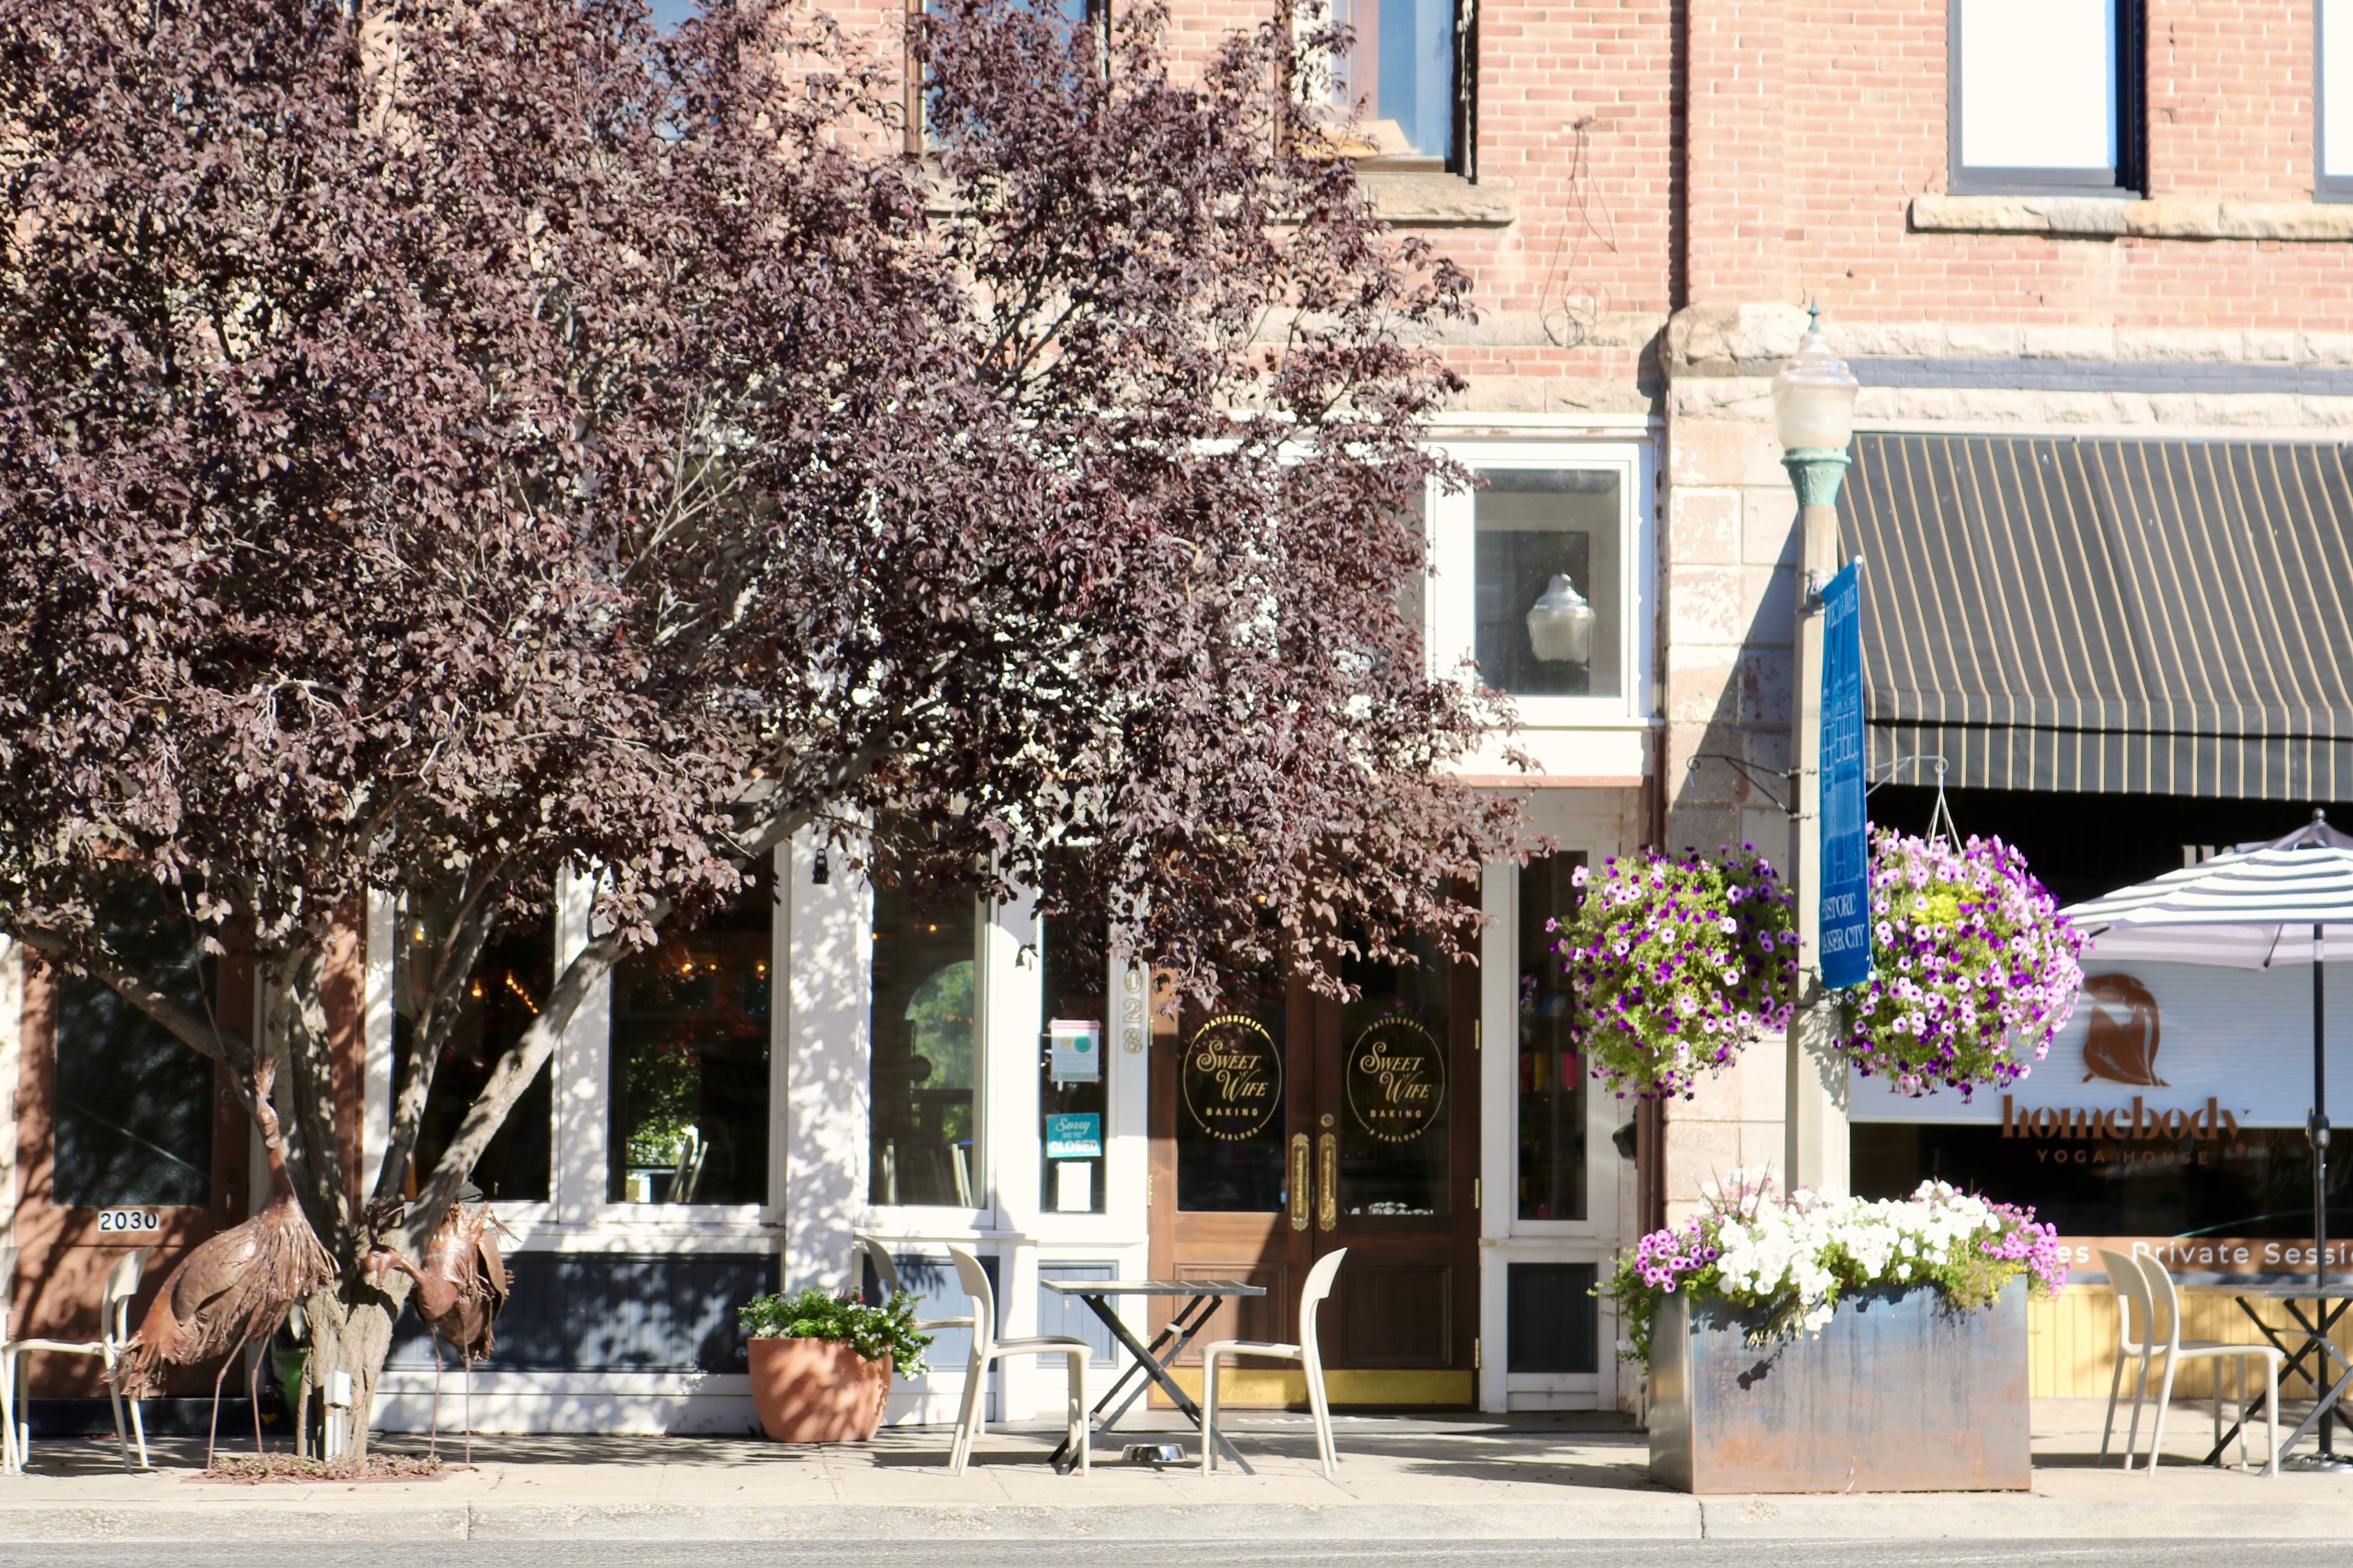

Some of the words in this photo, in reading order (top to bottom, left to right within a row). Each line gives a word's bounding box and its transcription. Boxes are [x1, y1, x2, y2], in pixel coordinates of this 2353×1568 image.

[1822, 928, 1845, 954] AKER
[1845, 924, 1865, 949] CITY
[1123, 969, 1143, 1054] 028
[1204, 1015, 1262, 1031] PATISSERIE
[1368, 1017, 1424, 1032] PATISSERIE
[1206, 1108, 1258, 1116] BAKING
[1055, 1117, 1091, 1135] Sorry
[2001, 1094, 2252, 1155] homebody
[1214, 1127, 1259, 1141] PARLOUR
[1378, 1129, 1422, 1142] PARLOUR
[1050, 1139, 1099, 1153] CLOSED
[2037, 1150, 2106, 1164] YOGA
[2123, 1150, 2209, 1165] HOUSE
[101, 1212, 157, 1230] 2030
[2132, 1241, 2249, 1265] Private
[2265, 1242, 2353, 1265] Sessi
